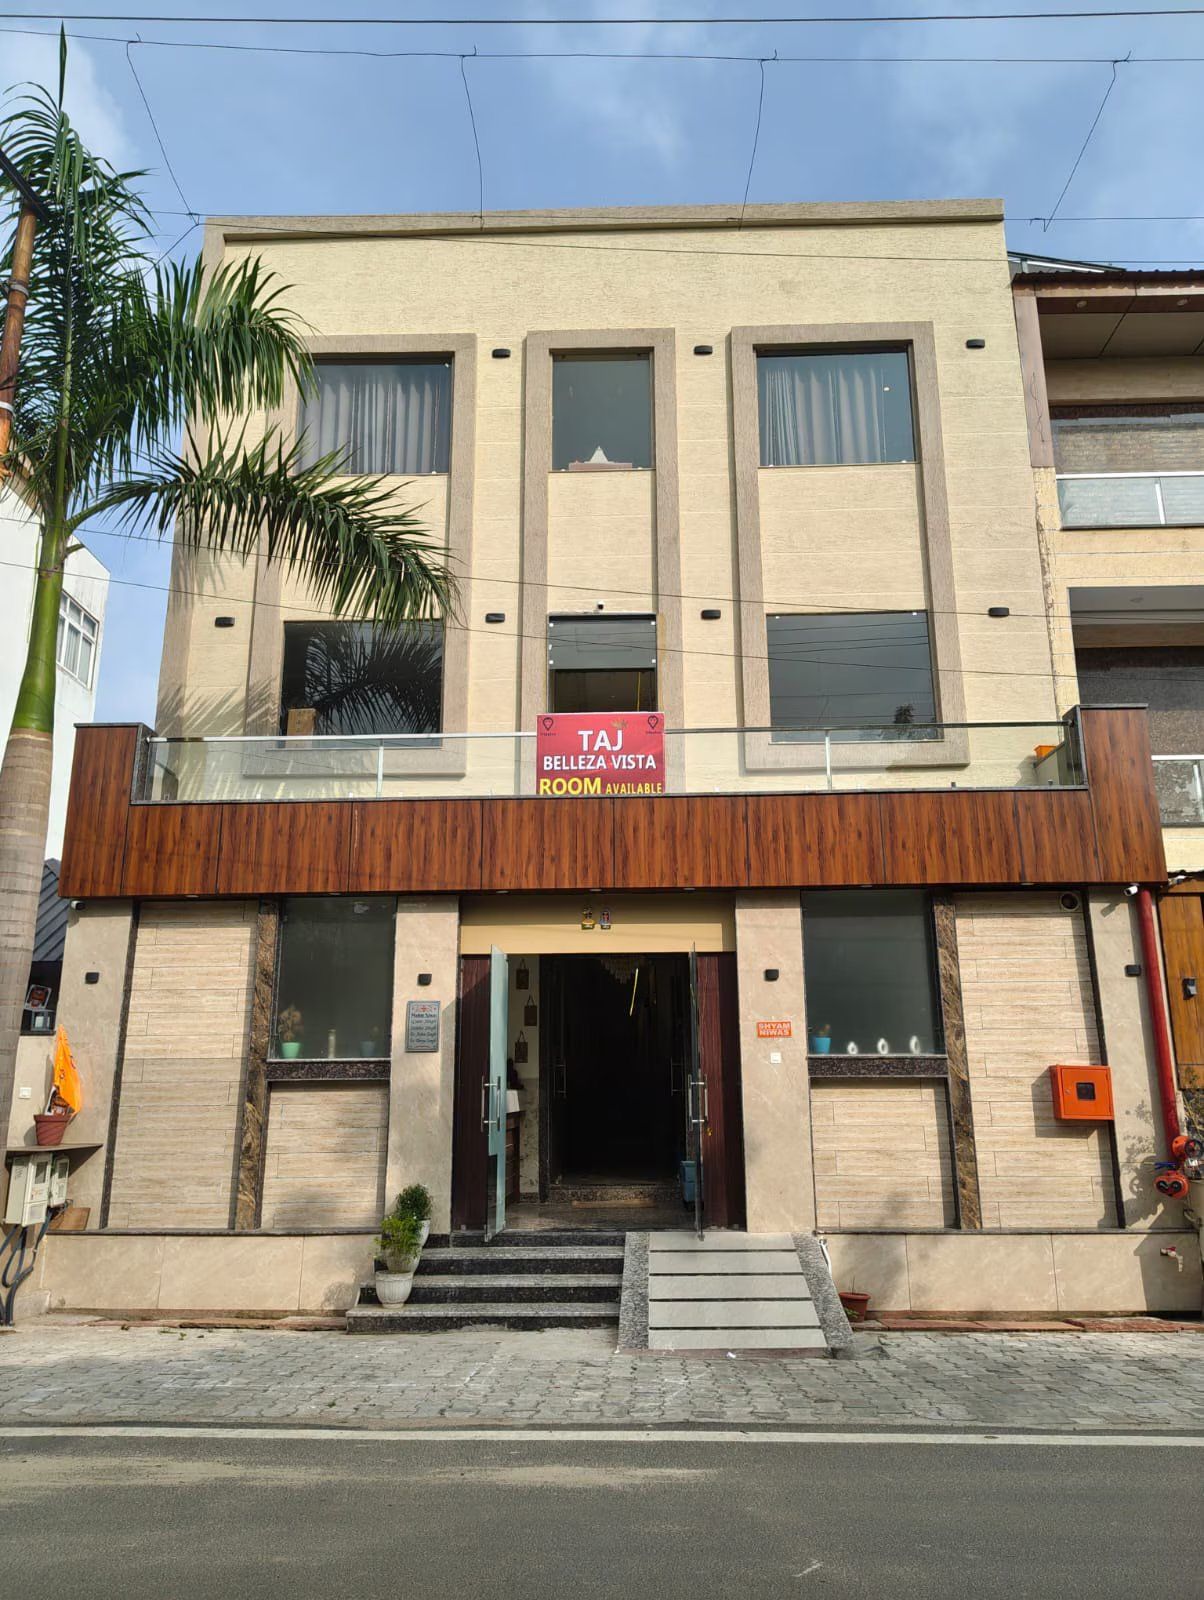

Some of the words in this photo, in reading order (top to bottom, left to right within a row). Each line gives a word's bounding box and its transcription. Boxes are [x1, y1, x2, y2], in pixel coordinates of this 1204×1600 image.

[578, 730, 623, 751] TAJ
[543, 755, 607, 770] BELLEZA
[611, 754, 657, 769] VISTA
[540, 777, 601, 795] ROOM
[606, 783, 662, 794] AVAILABLE
